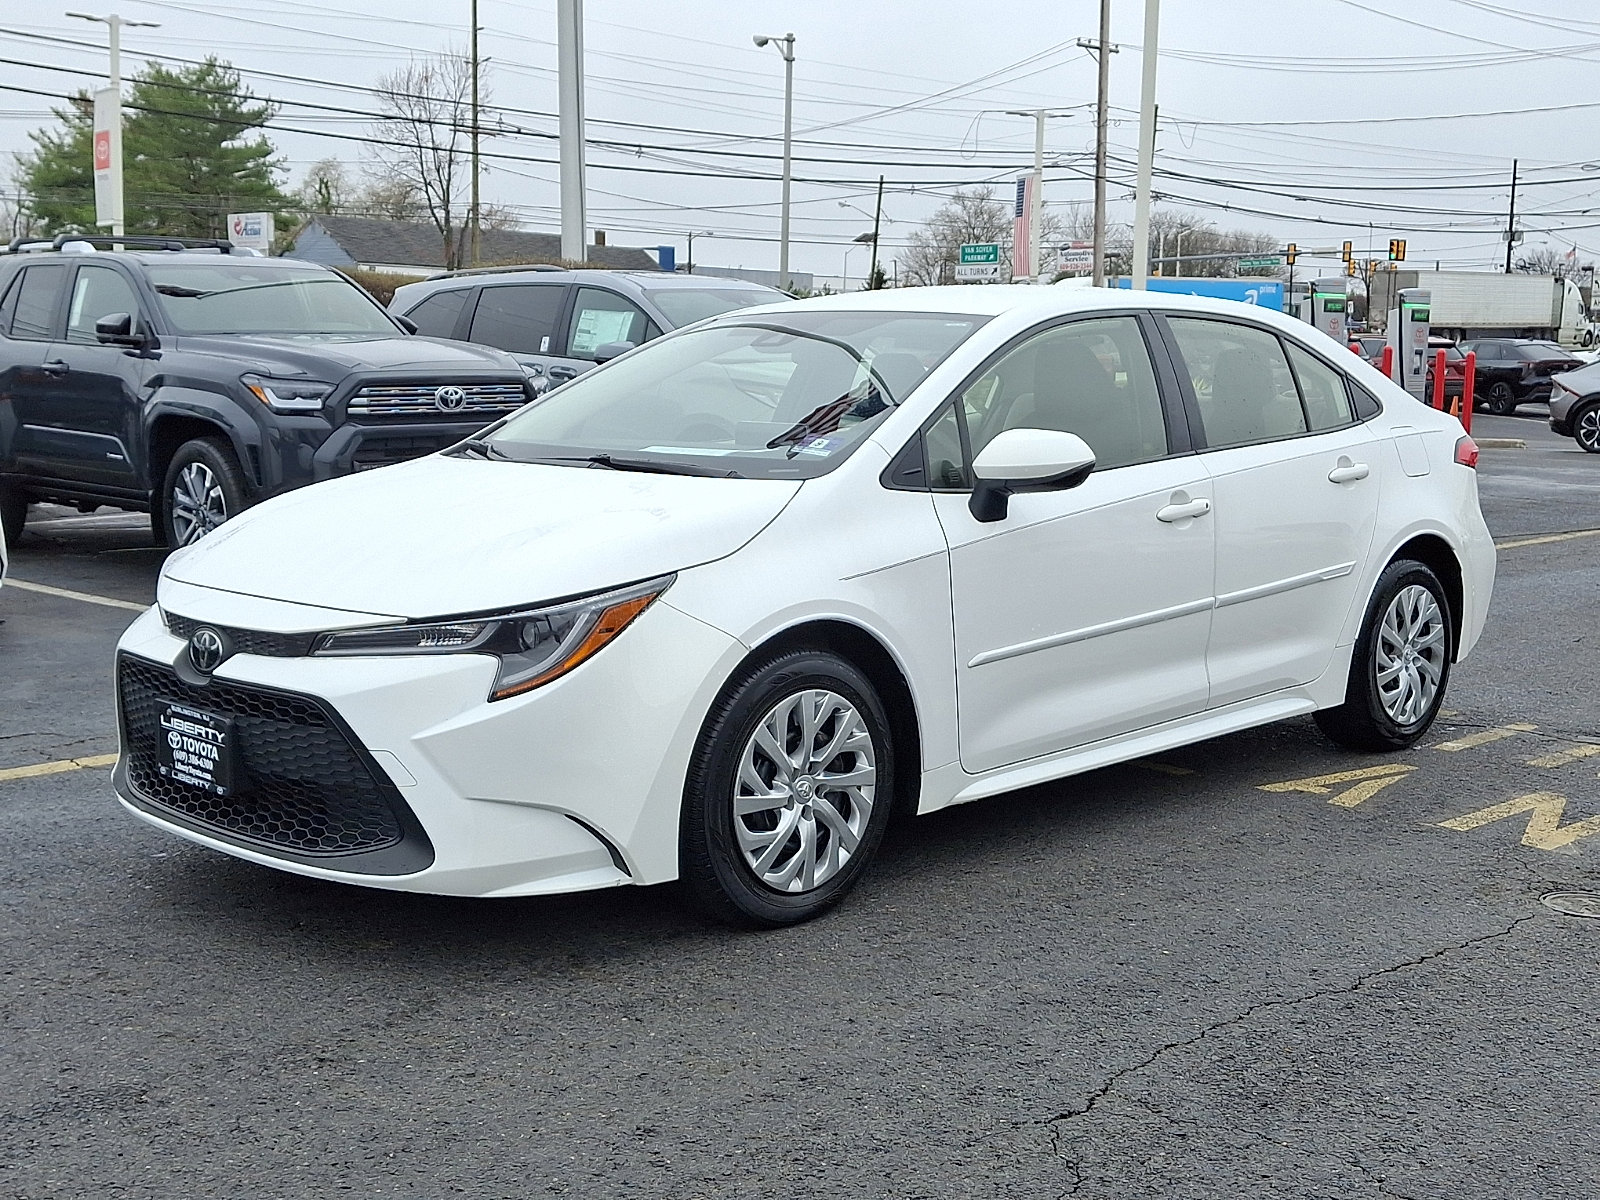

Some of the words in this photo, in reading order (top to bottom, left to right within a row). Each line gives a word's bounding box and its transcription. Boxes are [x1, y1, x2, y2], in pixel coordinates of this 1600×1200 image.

[956, 267, 967, 276] ALL
[969, 267, 988, 276] TURNS
[1259, 285, 1276, 295] prime
[160, 714, 225, 743] LIBERTY
[182, 736, 220, 761] TOYOTA
[171, 770, 212, 790] LIBERTY
